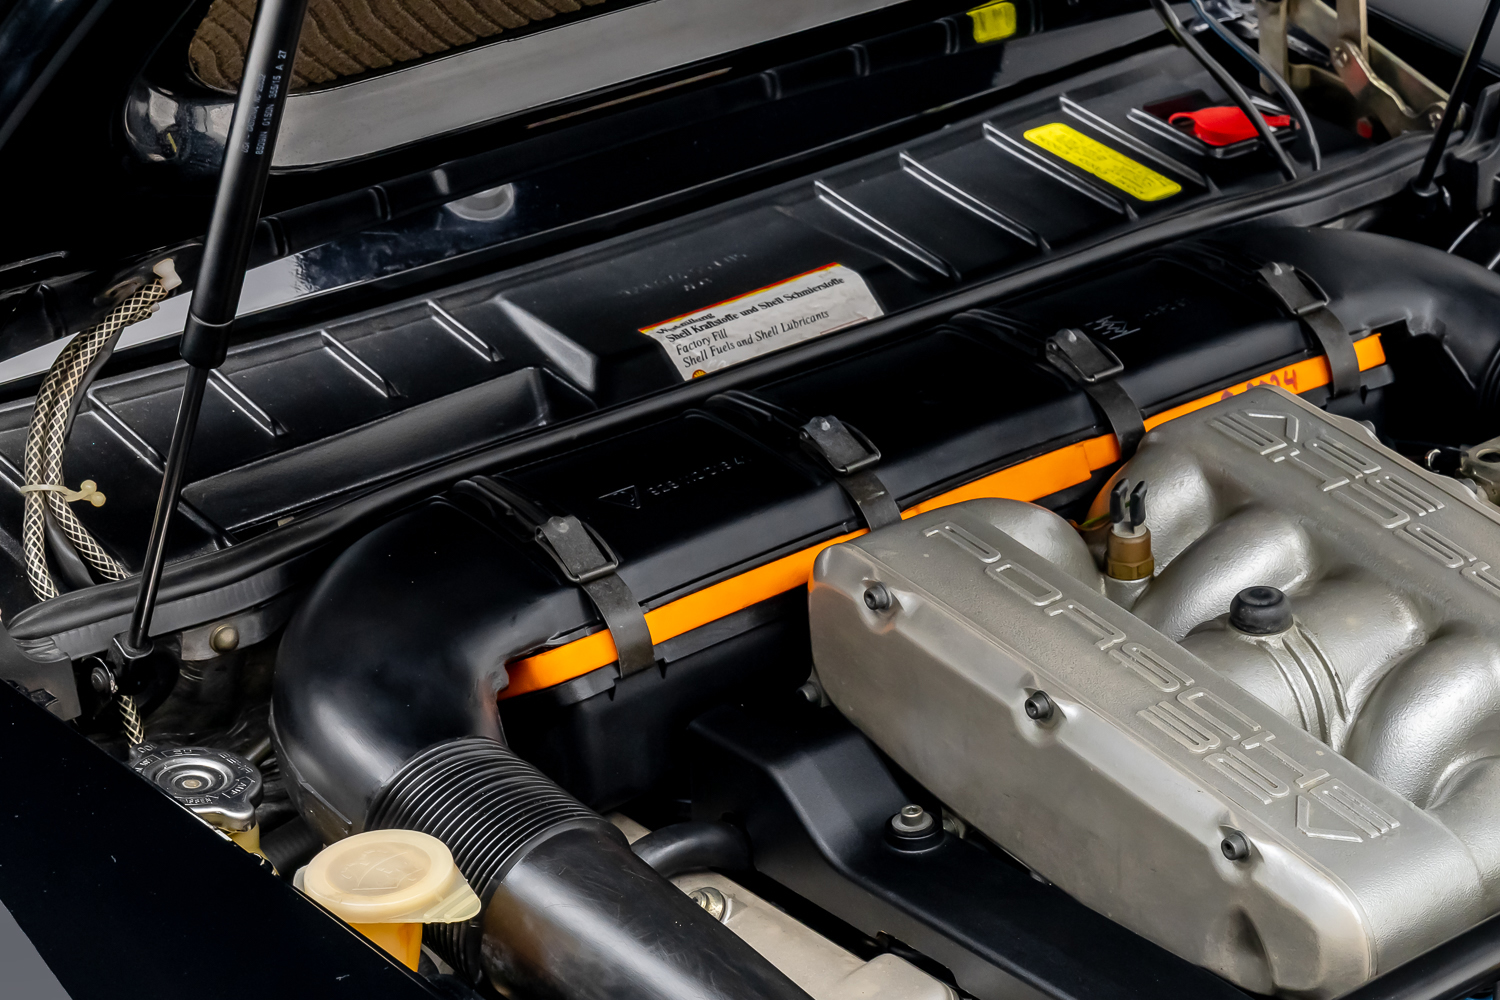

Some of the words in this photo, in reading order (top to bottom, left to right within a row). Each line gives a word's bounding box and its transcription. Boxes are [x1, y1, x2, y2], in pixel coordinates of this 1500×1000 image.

[665, 328, 692, 343] Shell
[692, 312, 739, 335] Kraftstoffe
[740, 305, 759, 317] und
[760, 296, 783, 310] Shell
[784, 277, 845, 301] Schmierstoffe
[675, 335, 711, 355] Factory
[711, 328, 728, 341] Fill
[682, 350, 708, 368] Shell
[710, 342, 735, 360] Fuels
[736, 334, 753, 349] and
[756, 325, 779, 341] Shell
[781, 310, 830, 333] Lubricants
[922, 520, 1401, 839] PORSCHE
[1136, 702, 1364, 843] 32V
